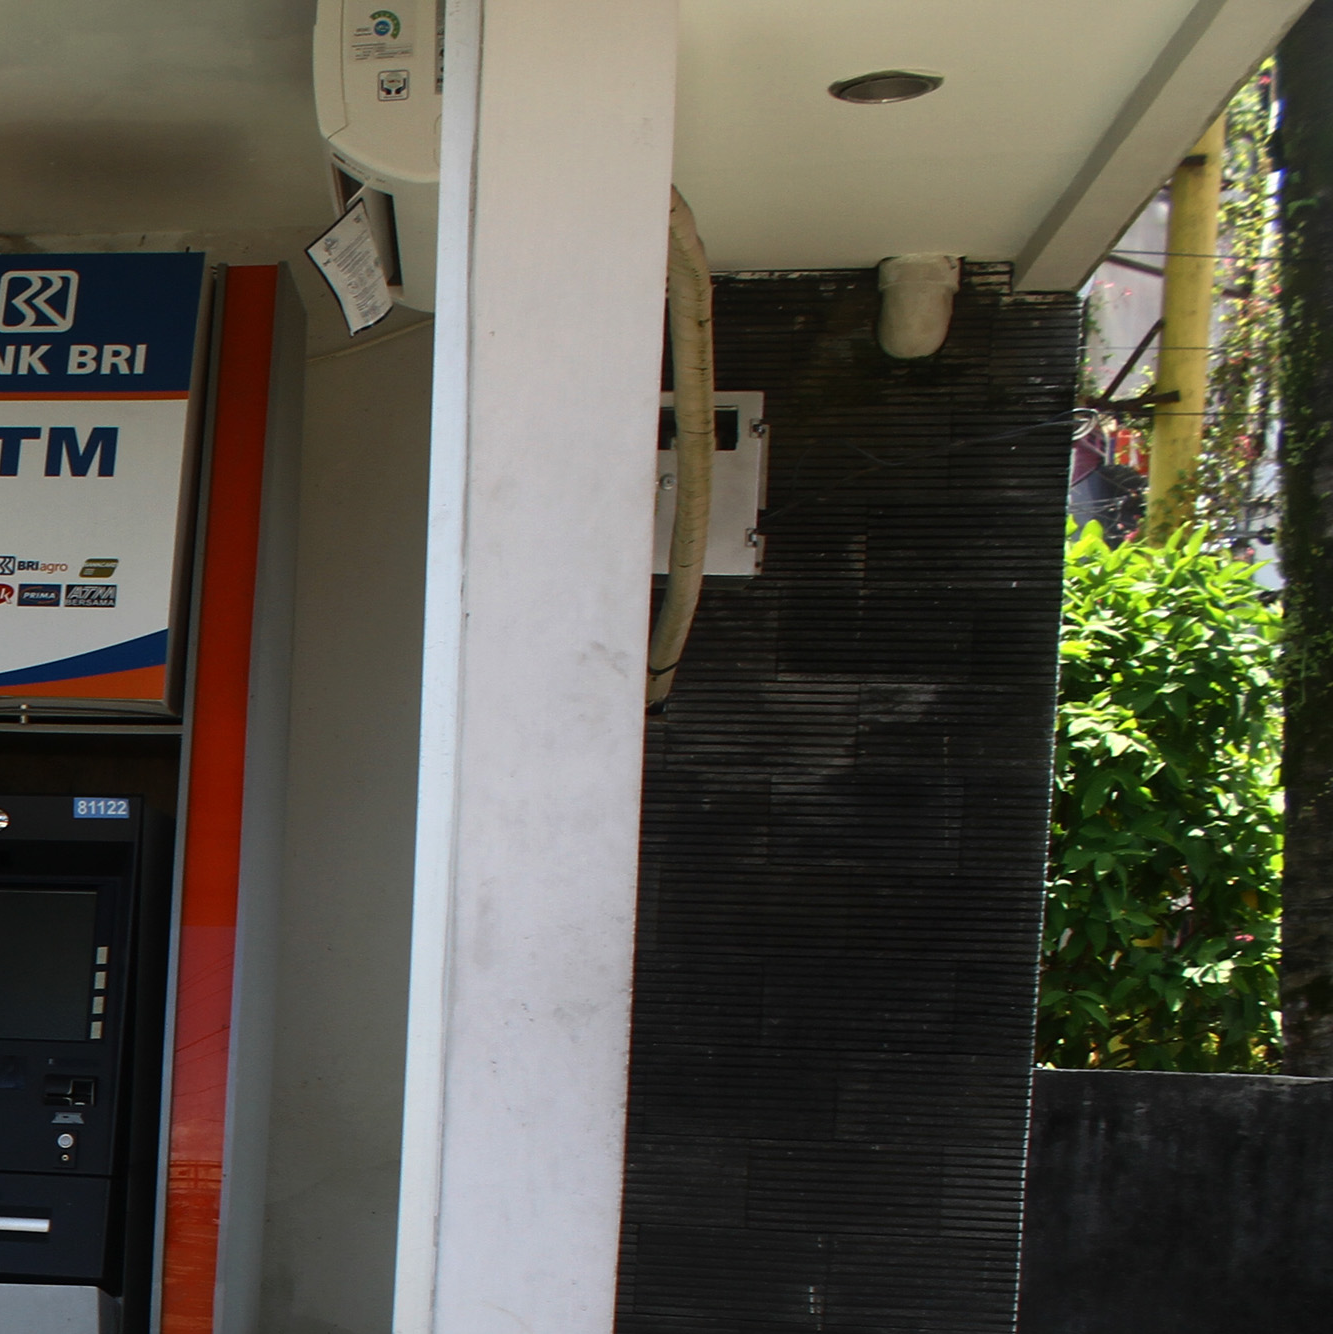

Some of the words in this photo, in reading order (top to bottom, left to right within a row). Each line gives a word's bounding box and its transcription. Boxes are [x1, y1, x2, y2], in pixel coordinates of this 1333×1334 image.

[66, 343, 148, 375] BRI
[17, 560, 69, 574] BRIagro
[23, 592, 56, 600] PRIMA
[66, 585, 116, 600] ATM
[77, 800, 128, 815] 81122
